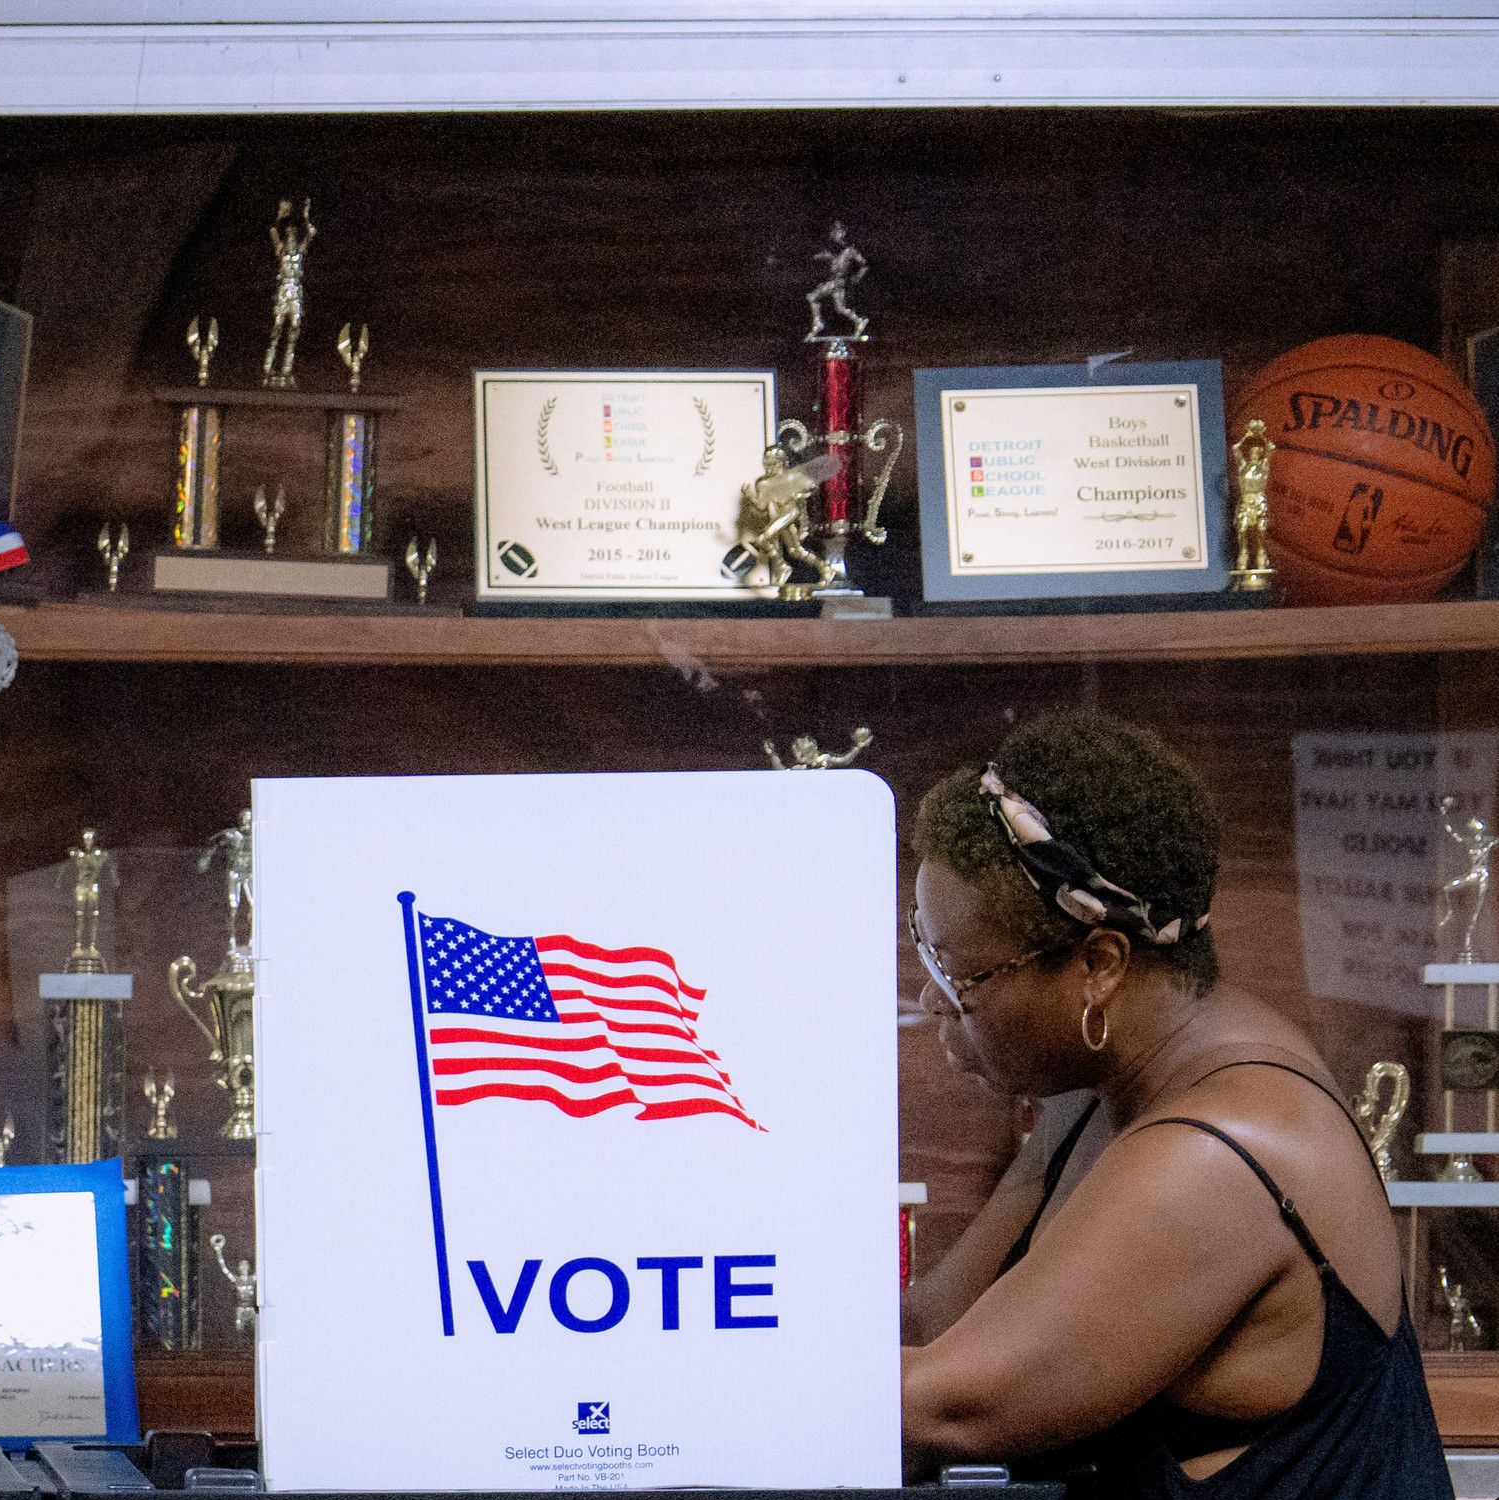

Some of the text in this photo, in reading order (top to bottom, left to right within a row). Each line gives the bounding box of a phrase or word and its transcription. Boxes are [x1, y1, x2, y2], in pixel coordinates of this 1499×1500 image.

[1108, 416, 1148, 431] Boys
[1089, 434, 1169, 448] Basketball
[1281, 390, 1475, 481] SPALDING
[969, 440, 1044, 451] DETROIT
[1074, 454, 1186, 469] West Division II
[597, 480, 654, 493] Football
[1077, 485, 1187, 504] Champions
[584, 498, 671, 511] DIVISION II
[536, 518, 722, 533] West League Champions
[1096, 538, 1174, 550] 2016-2017
[588, 548, 622, 561] 2015
[637, 548, 672, 561] 2016
[466, 1254, 779, 1334] VOTE
[572, 1416, 611, 1430] select
[505, 1444, 680, 1461] Select Duo Voting Booth
[529, 1461, 654, 1472] www.selectvotingbooths.com
[558, 1473, 625, 1482] Part No. VB-201
